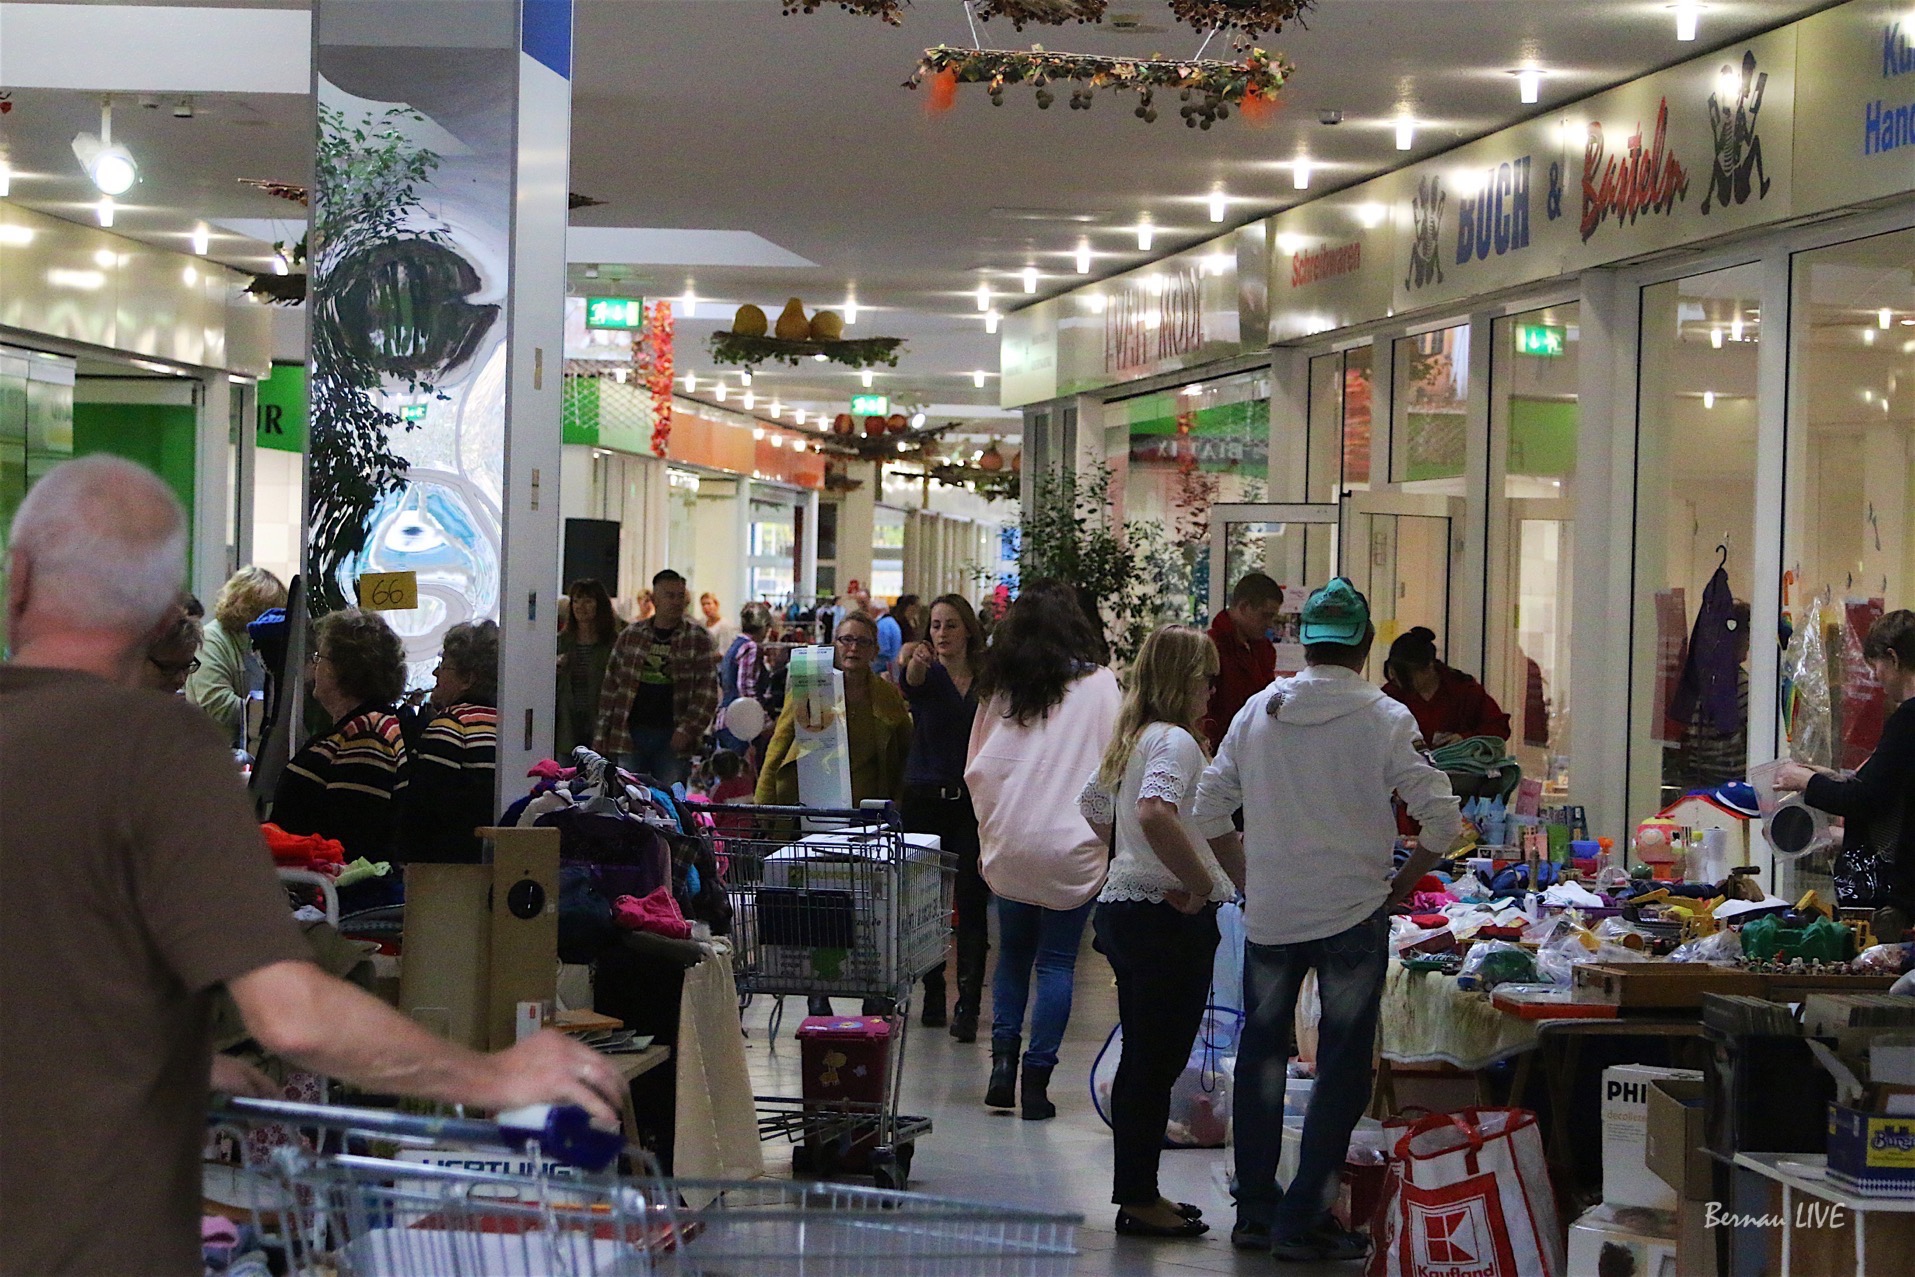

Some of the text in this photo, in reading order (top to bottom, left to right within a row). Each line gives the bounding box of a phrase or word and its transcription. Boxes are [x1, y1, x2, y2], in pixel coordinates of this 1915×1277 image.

[1456, 155, 1531, 265] BUCH
[1547, 161, 1562, 221] &
[372, 579, 404, 605] 66
